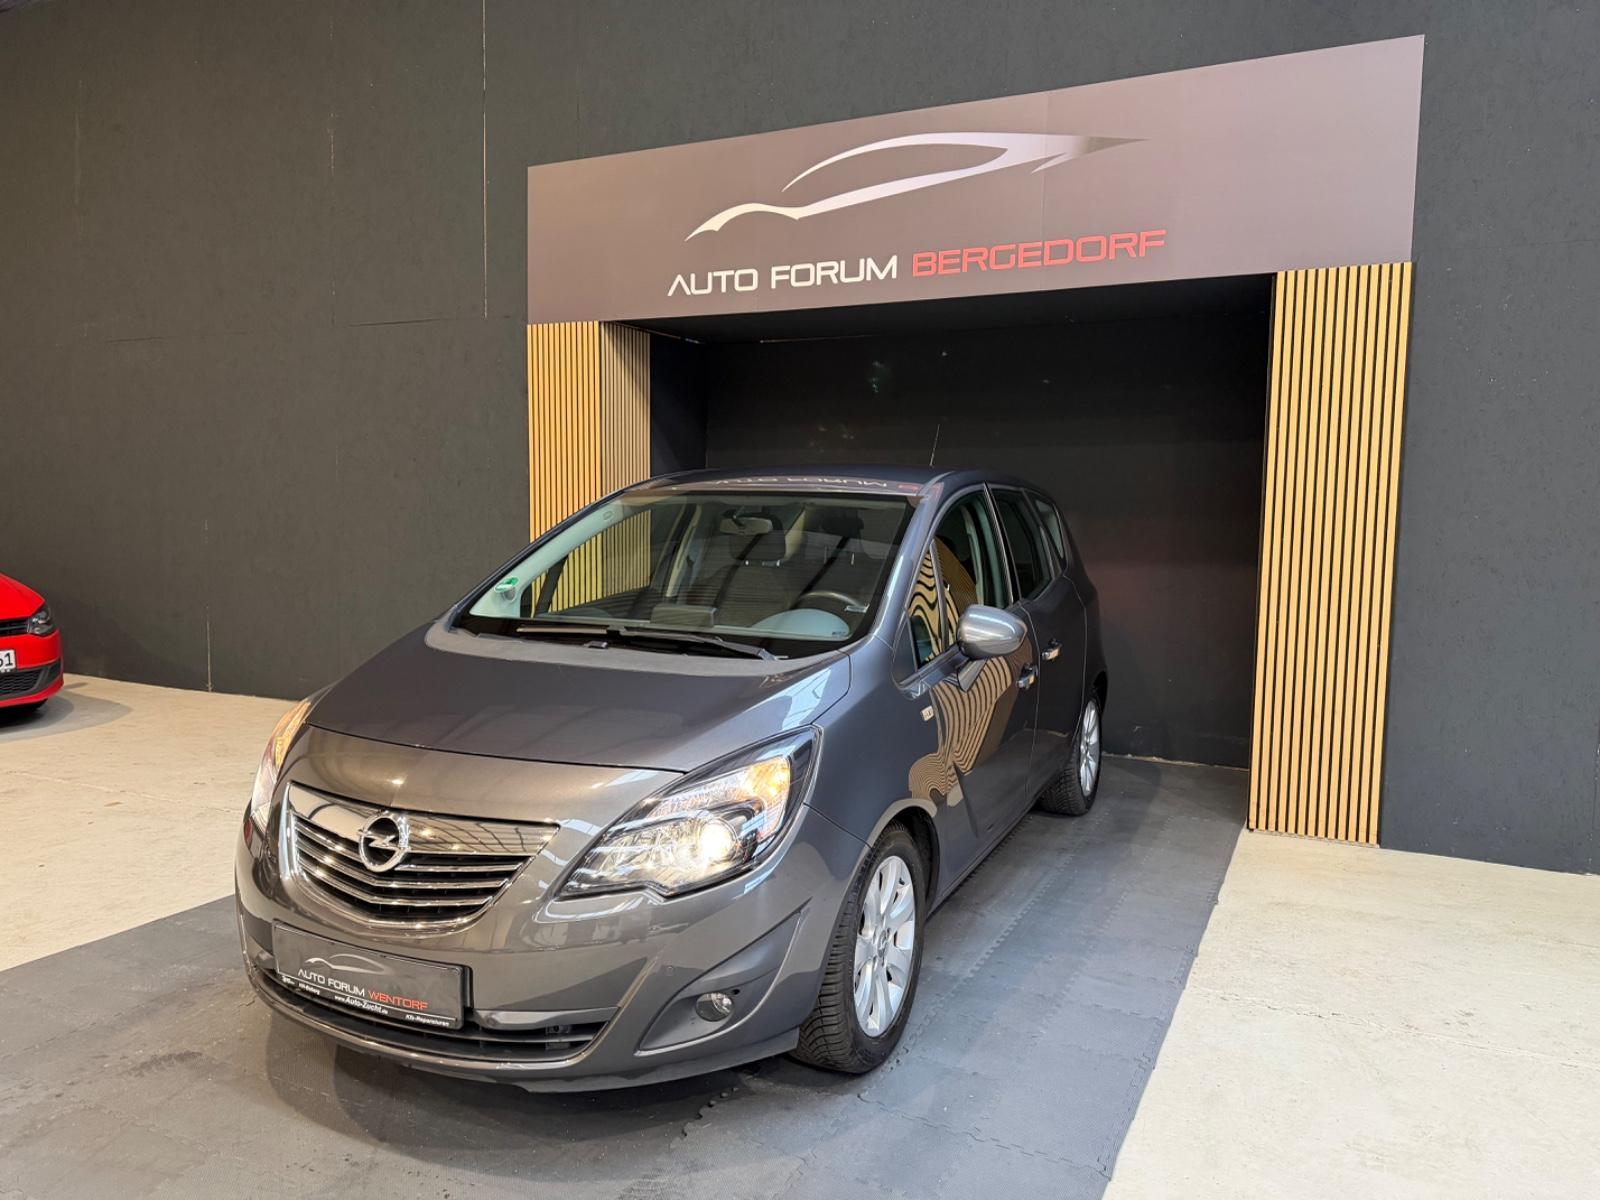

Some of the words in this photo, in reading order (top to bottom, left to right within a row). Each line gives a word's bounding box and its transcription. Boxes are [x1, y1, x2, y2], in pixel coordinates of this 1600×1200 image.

[667, 267, 760, 297] AUTO
[769, 254, 899, 291] FORUM
[911, 228, 1167, 278] BERGEDORF
[297, 968, 326, 985] AUTO
[327, 977, 365, 997] FORUM
[367, 990, 429, 1011] WENTORF
